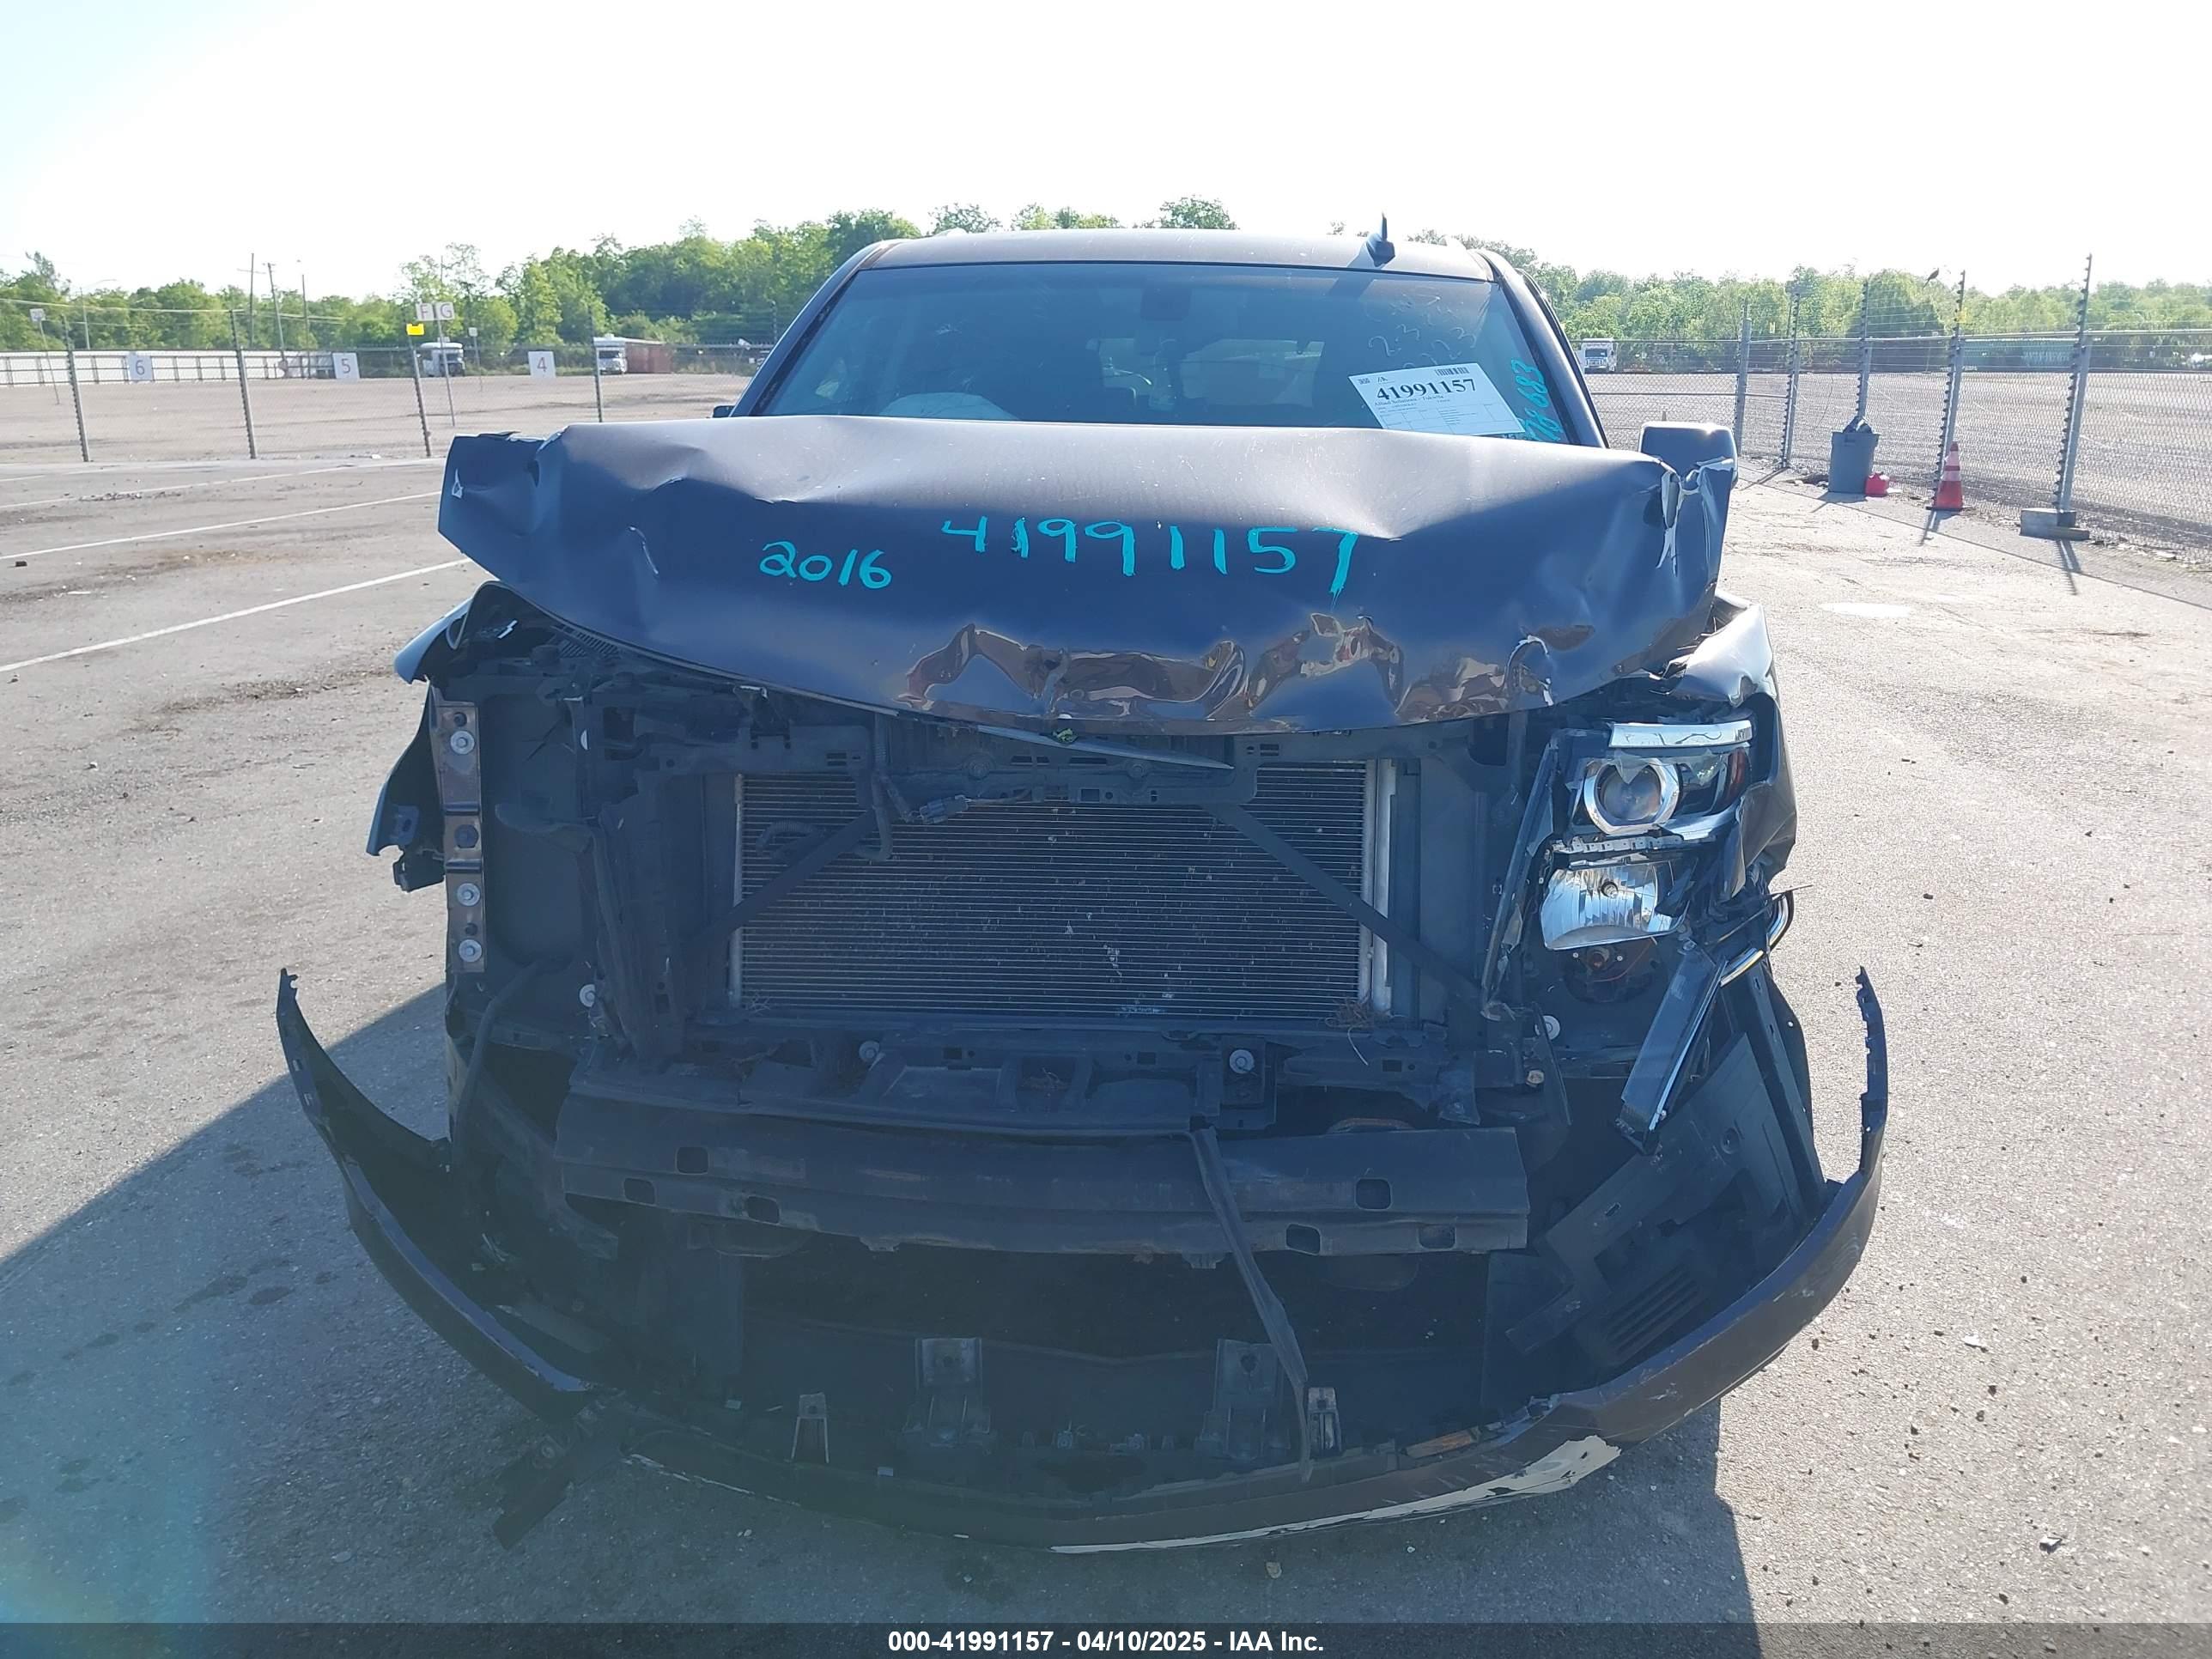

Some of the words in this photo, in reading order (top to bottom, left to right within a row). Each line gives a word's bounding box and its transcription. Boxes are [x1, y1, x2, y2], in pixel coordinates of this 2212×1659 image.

[420, 303, 430, 319] F
[441, 303, 453, 319] G
[135, 359, 145, 376] 6
[341, 358, 351, 374] 5
[537, 356, 548, 373] 4
[1376, 378, 1476, 400] 41991157
[759, 540, 892, 589] 2016
[942, 516, 1359, 599] 41991157
